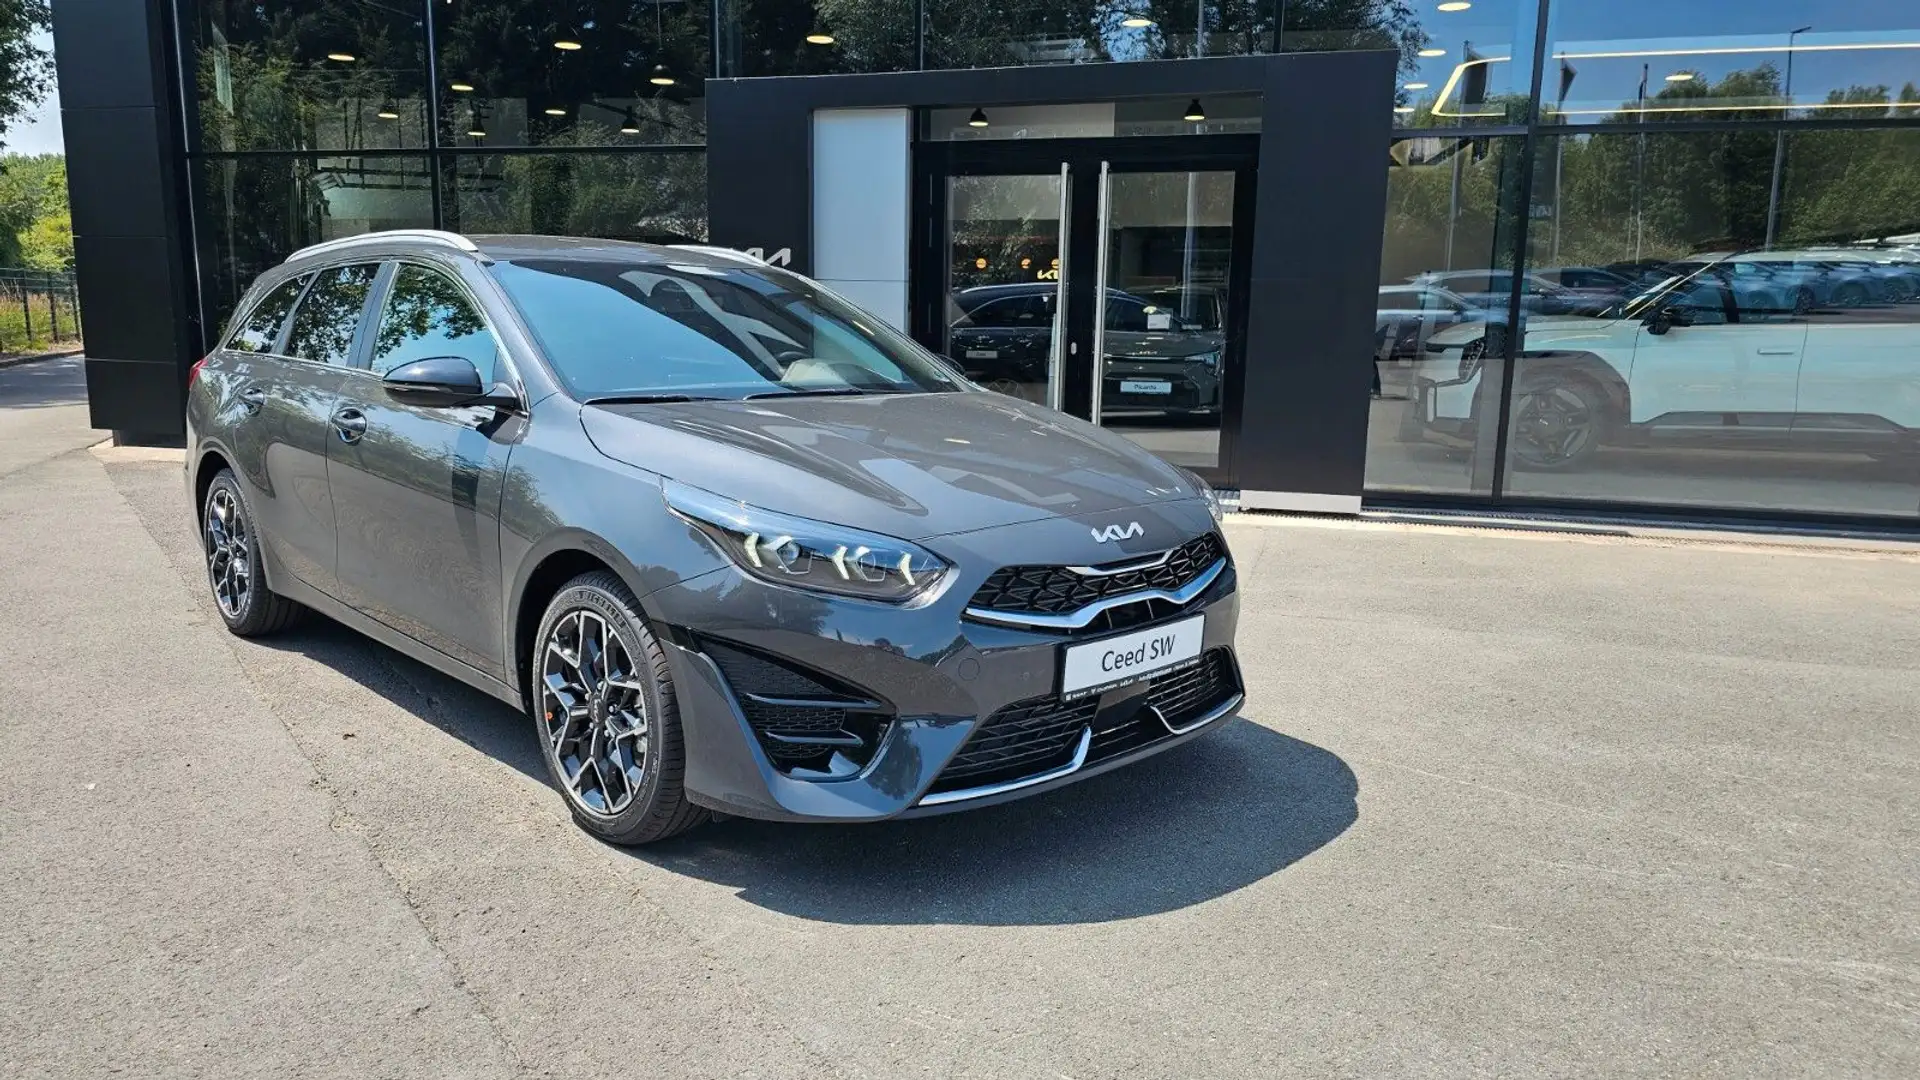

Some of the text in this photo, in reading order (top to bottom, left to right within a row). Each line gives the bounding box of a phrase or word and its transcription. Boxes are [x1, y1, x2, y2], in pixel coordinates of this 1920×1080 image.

[1091, 521, 1145, 543] KIA
[1102, 634, 1176, 672] Ceed SW
